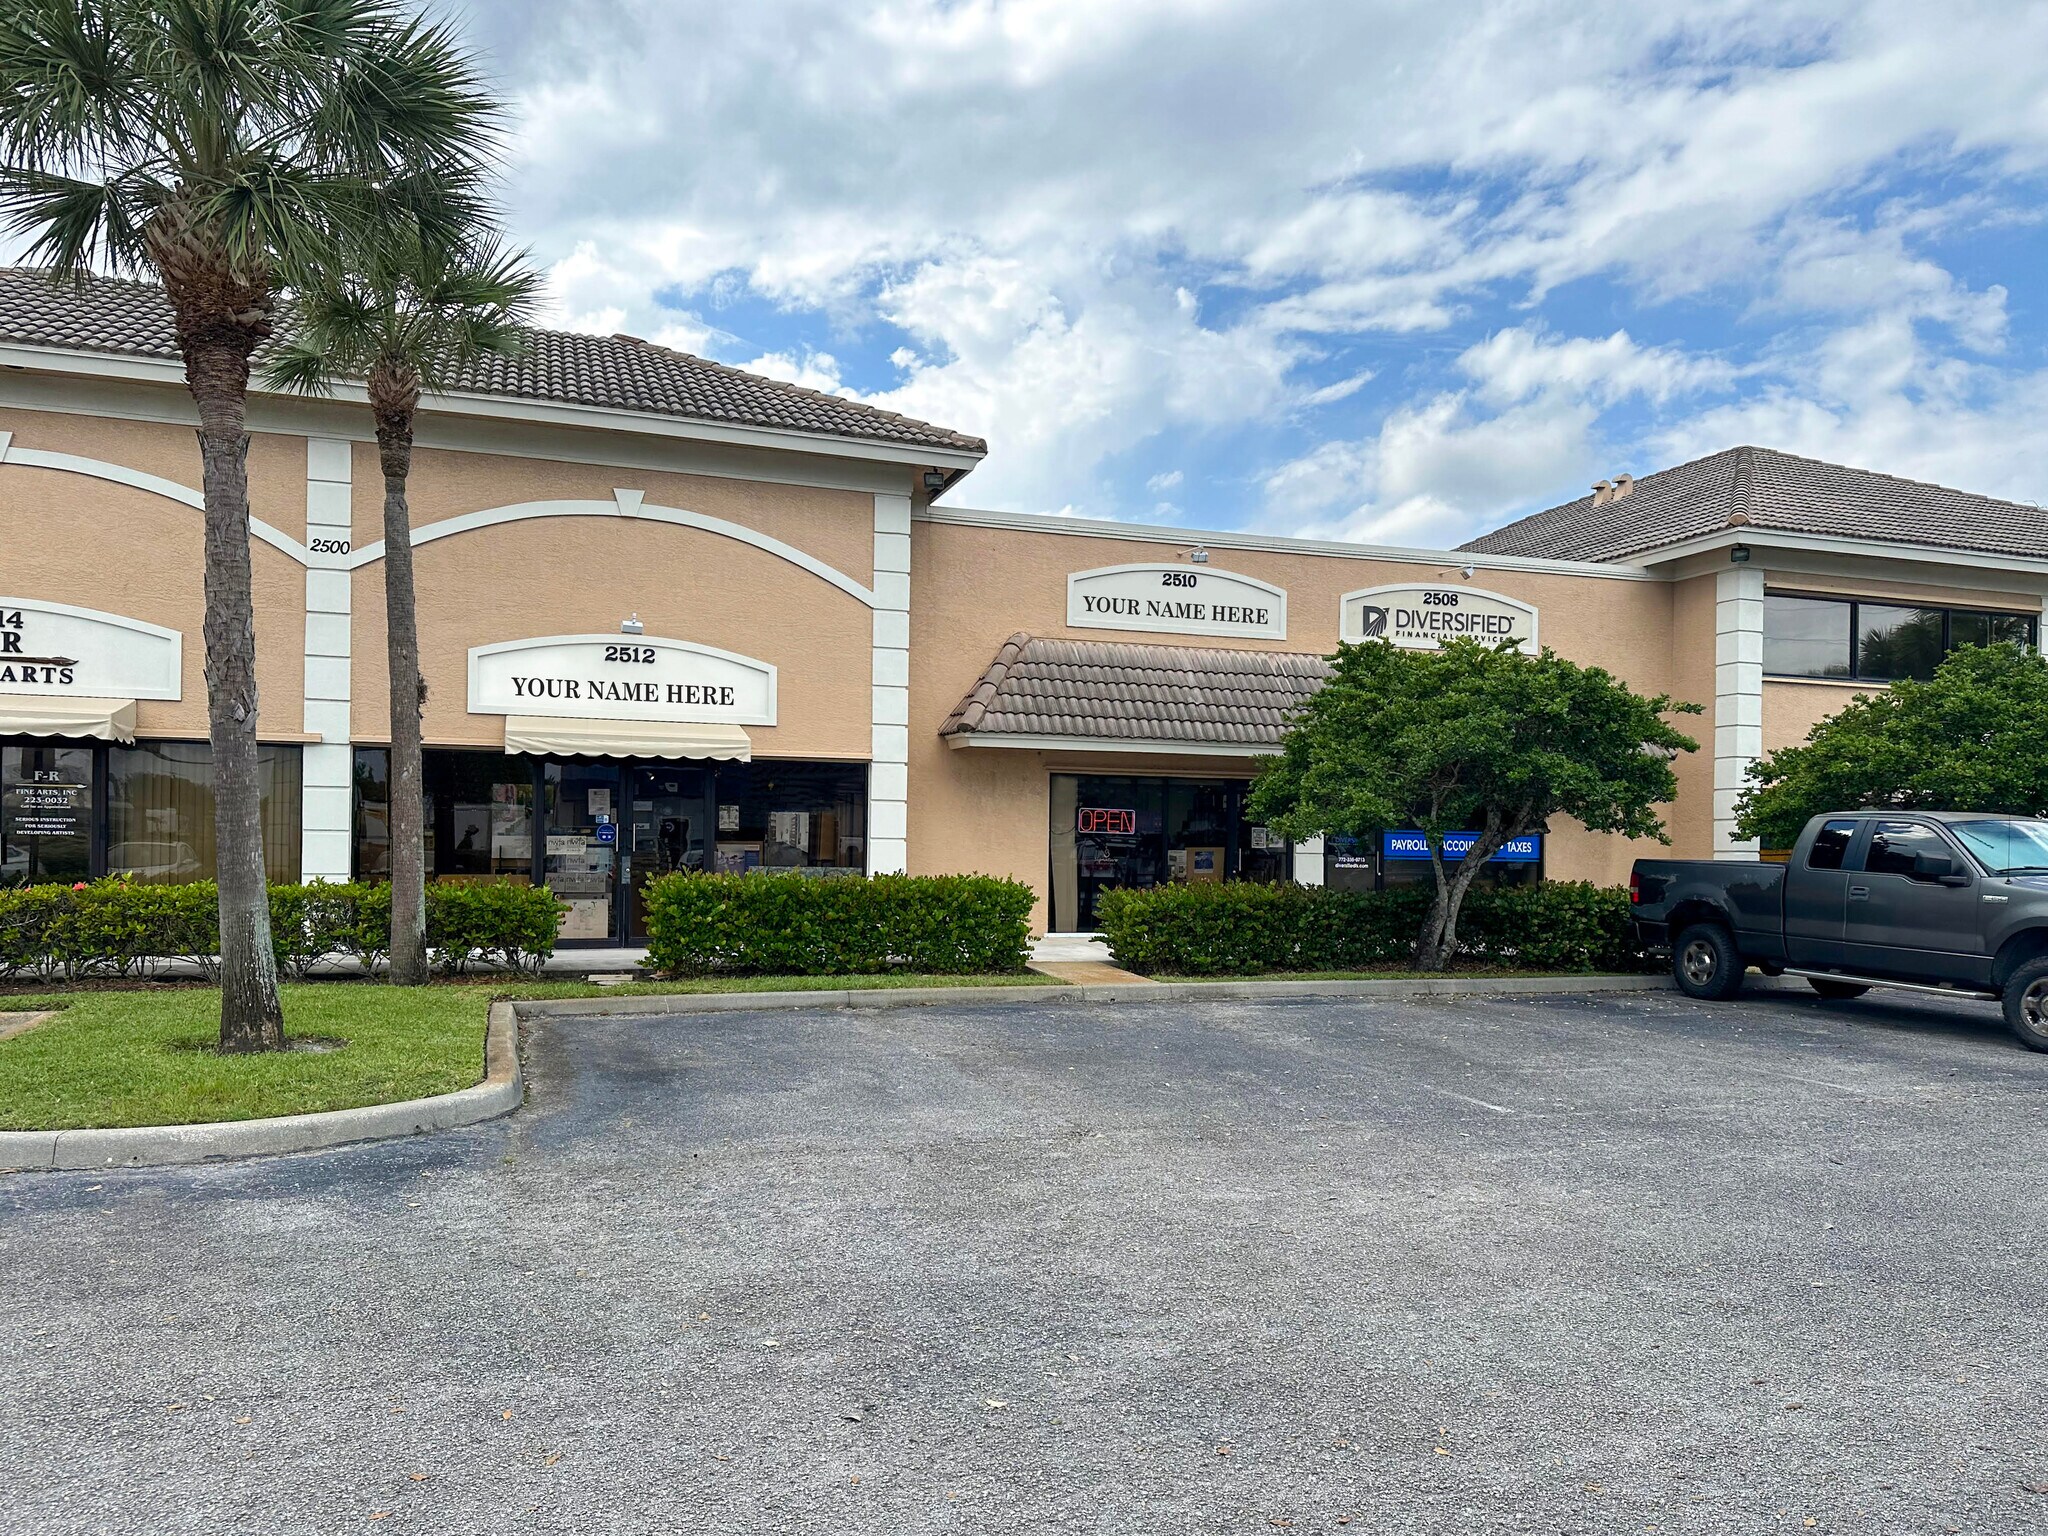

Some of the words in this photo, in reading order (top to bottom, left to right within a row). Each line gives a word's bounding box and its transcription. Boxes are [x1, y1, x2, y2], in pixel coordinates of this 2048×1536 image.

[310, 538, 350, 555] 2500
[1162, 573, 1197, 588] 2510
[1423, 592, 1459, 606] 2508
[1083, 595, 1141, 616] YOUR
[1146, 600, 1206, 620] NAME
[1212, 605, 1269, 625] HERE
[1396, 609, 1513, 634] DIVERSIFIED
[604, 646, 656, 664] 2512
[0, 665, 74, 684] ARTS
[511, 677, 581, 699] YOUR
[588, 680, 659, 702] NAME
[666, 684, 735, 706] HERE
[34, 770, 60, 781] F-R
[24, 796, 68, 804] 223-0032
[1080, 809, 1135, 833] OPEN
[1391, 839, 1428, 851] PAYROLL
[1507, 841, 1532, 853] TAXES
